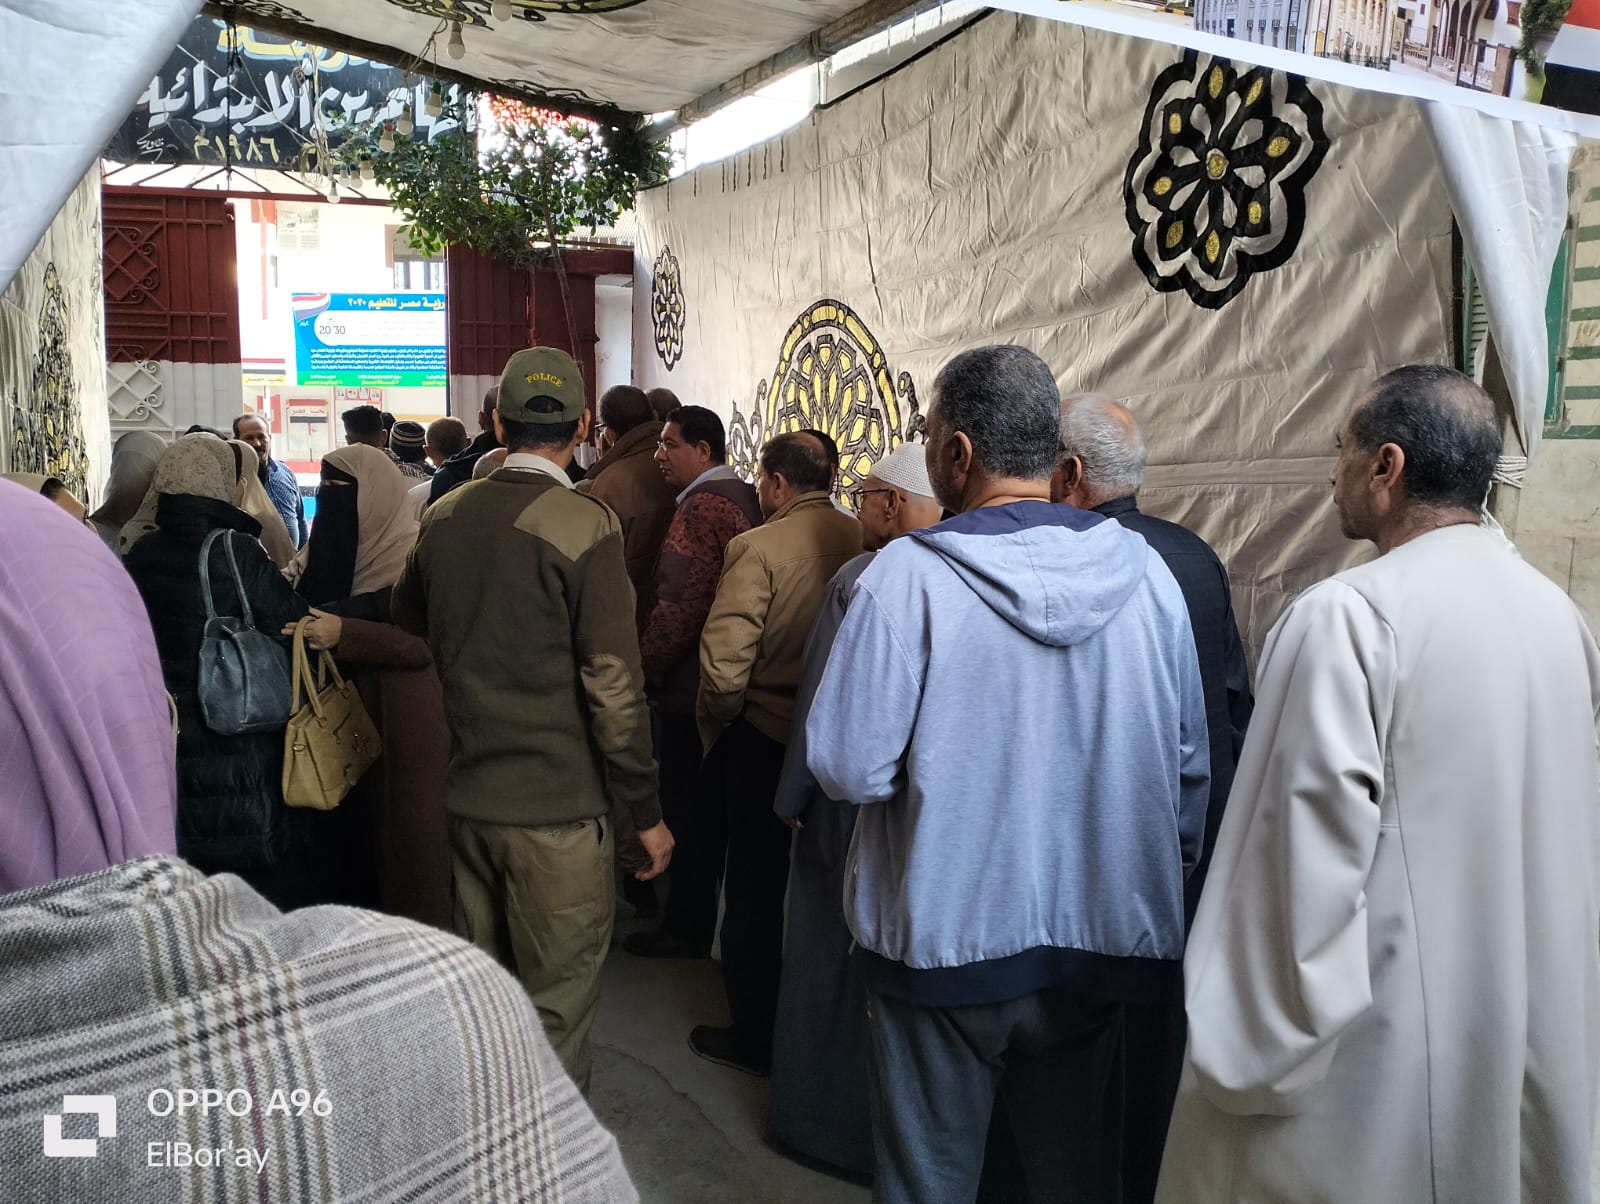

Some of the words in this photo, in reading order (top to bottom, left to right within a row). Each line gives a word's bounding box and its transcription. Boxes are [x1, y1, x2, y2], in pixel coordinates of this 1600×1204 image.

[368, 297, 398, 310] للتعليم
[397, 299, 421, 310] مصر
[526, 372, 563, 388] POLICE
